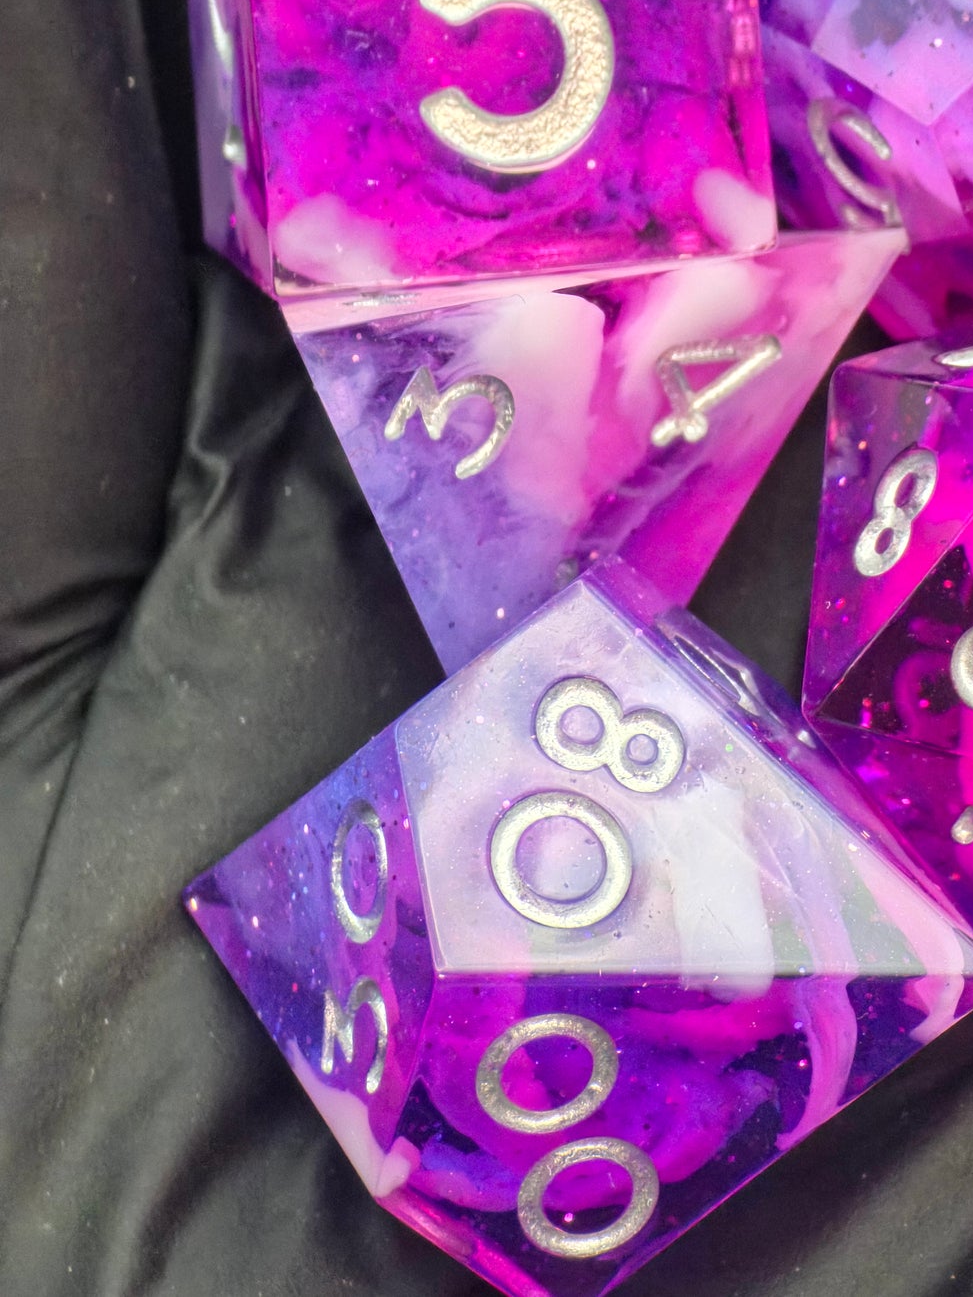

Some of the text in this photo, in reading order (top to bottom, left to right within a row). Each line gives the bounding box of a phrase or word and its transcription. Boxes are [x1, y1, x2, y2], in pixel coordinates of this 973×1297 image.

[383, 365, 517, 481] 3
[650, 333, 783, 448] 4
[853, 444, 939, 577] 8
[488, 675, 687, 930] 80
[319, 799, 390, 1095] 30
[475, 1012, 660, 1259] 00
